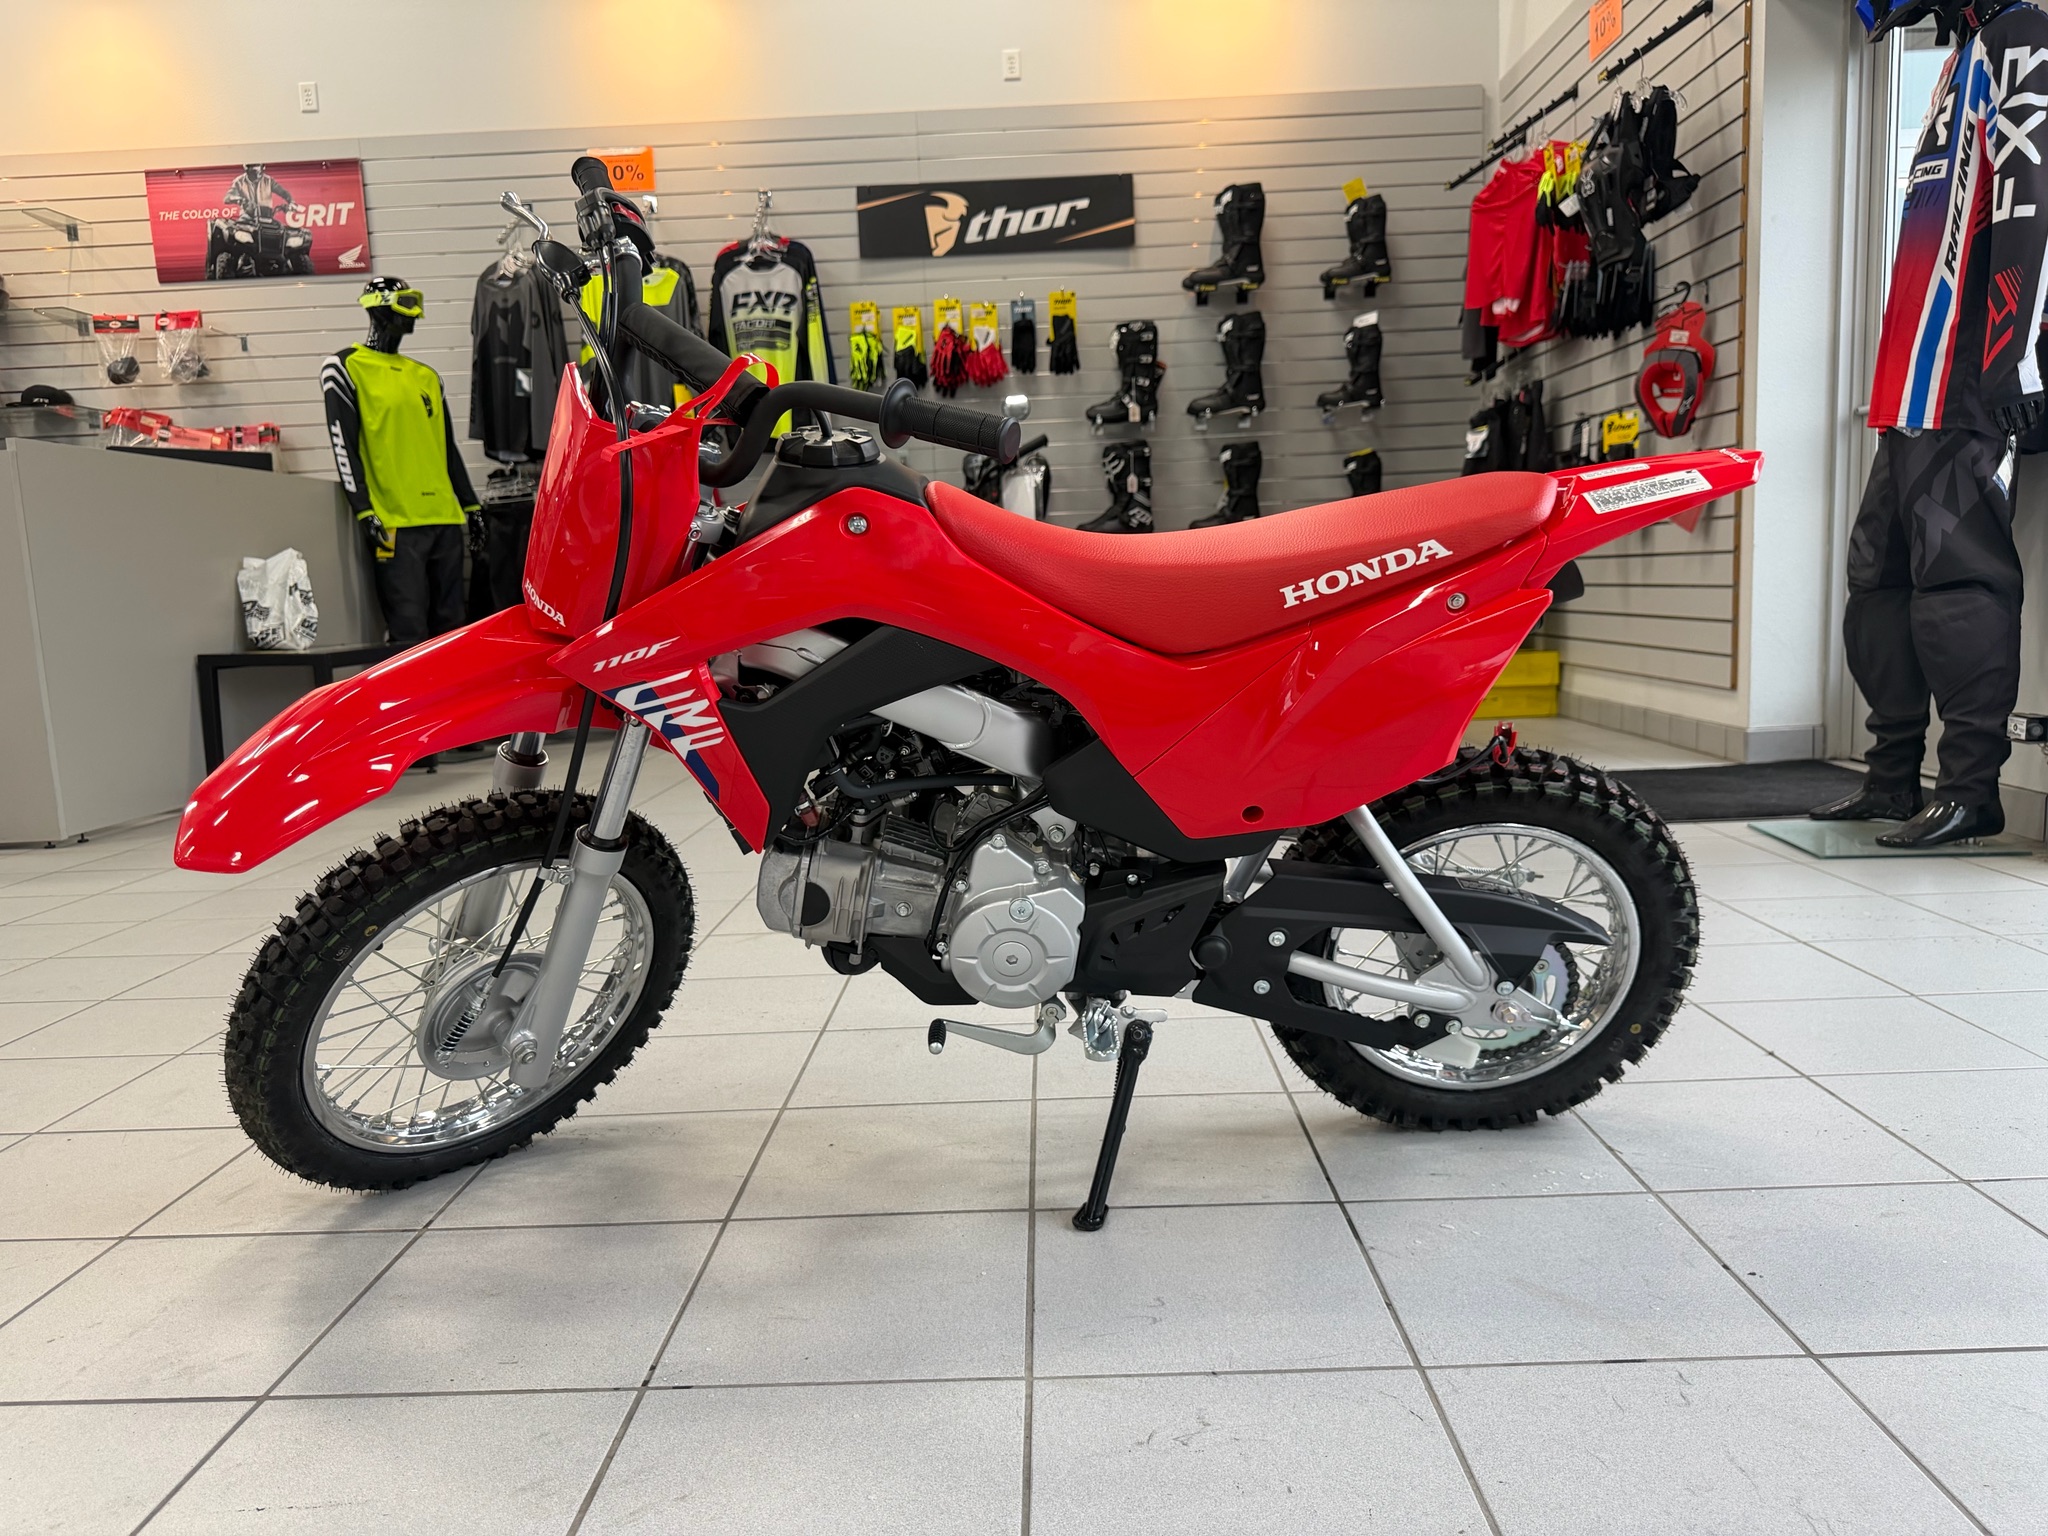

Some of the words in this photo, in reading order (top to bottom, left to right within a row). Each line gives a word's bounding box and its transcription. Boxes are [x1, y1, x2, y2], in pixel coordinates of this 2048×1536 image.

[613, 164, 645, 181] 0%
[1913, 164, 1943, 179] CING
[158, 211, 179, 221] THE
[182, 208, 219, 220] COLOR
[222, 206, 238, 218] OF
[1944, 111, 1975, 278] RACING
[285, 202, 355, 228] GRIT
[963, 197, 1091, 244] thor
[731, 291, 798, 317] FXR
[330, 419, 357, 493] THOR
[1279, 539, 1453, 608] HONDA
[524, 578, 566, 627] HONDA
[592, 635, 681, 673] 110F
